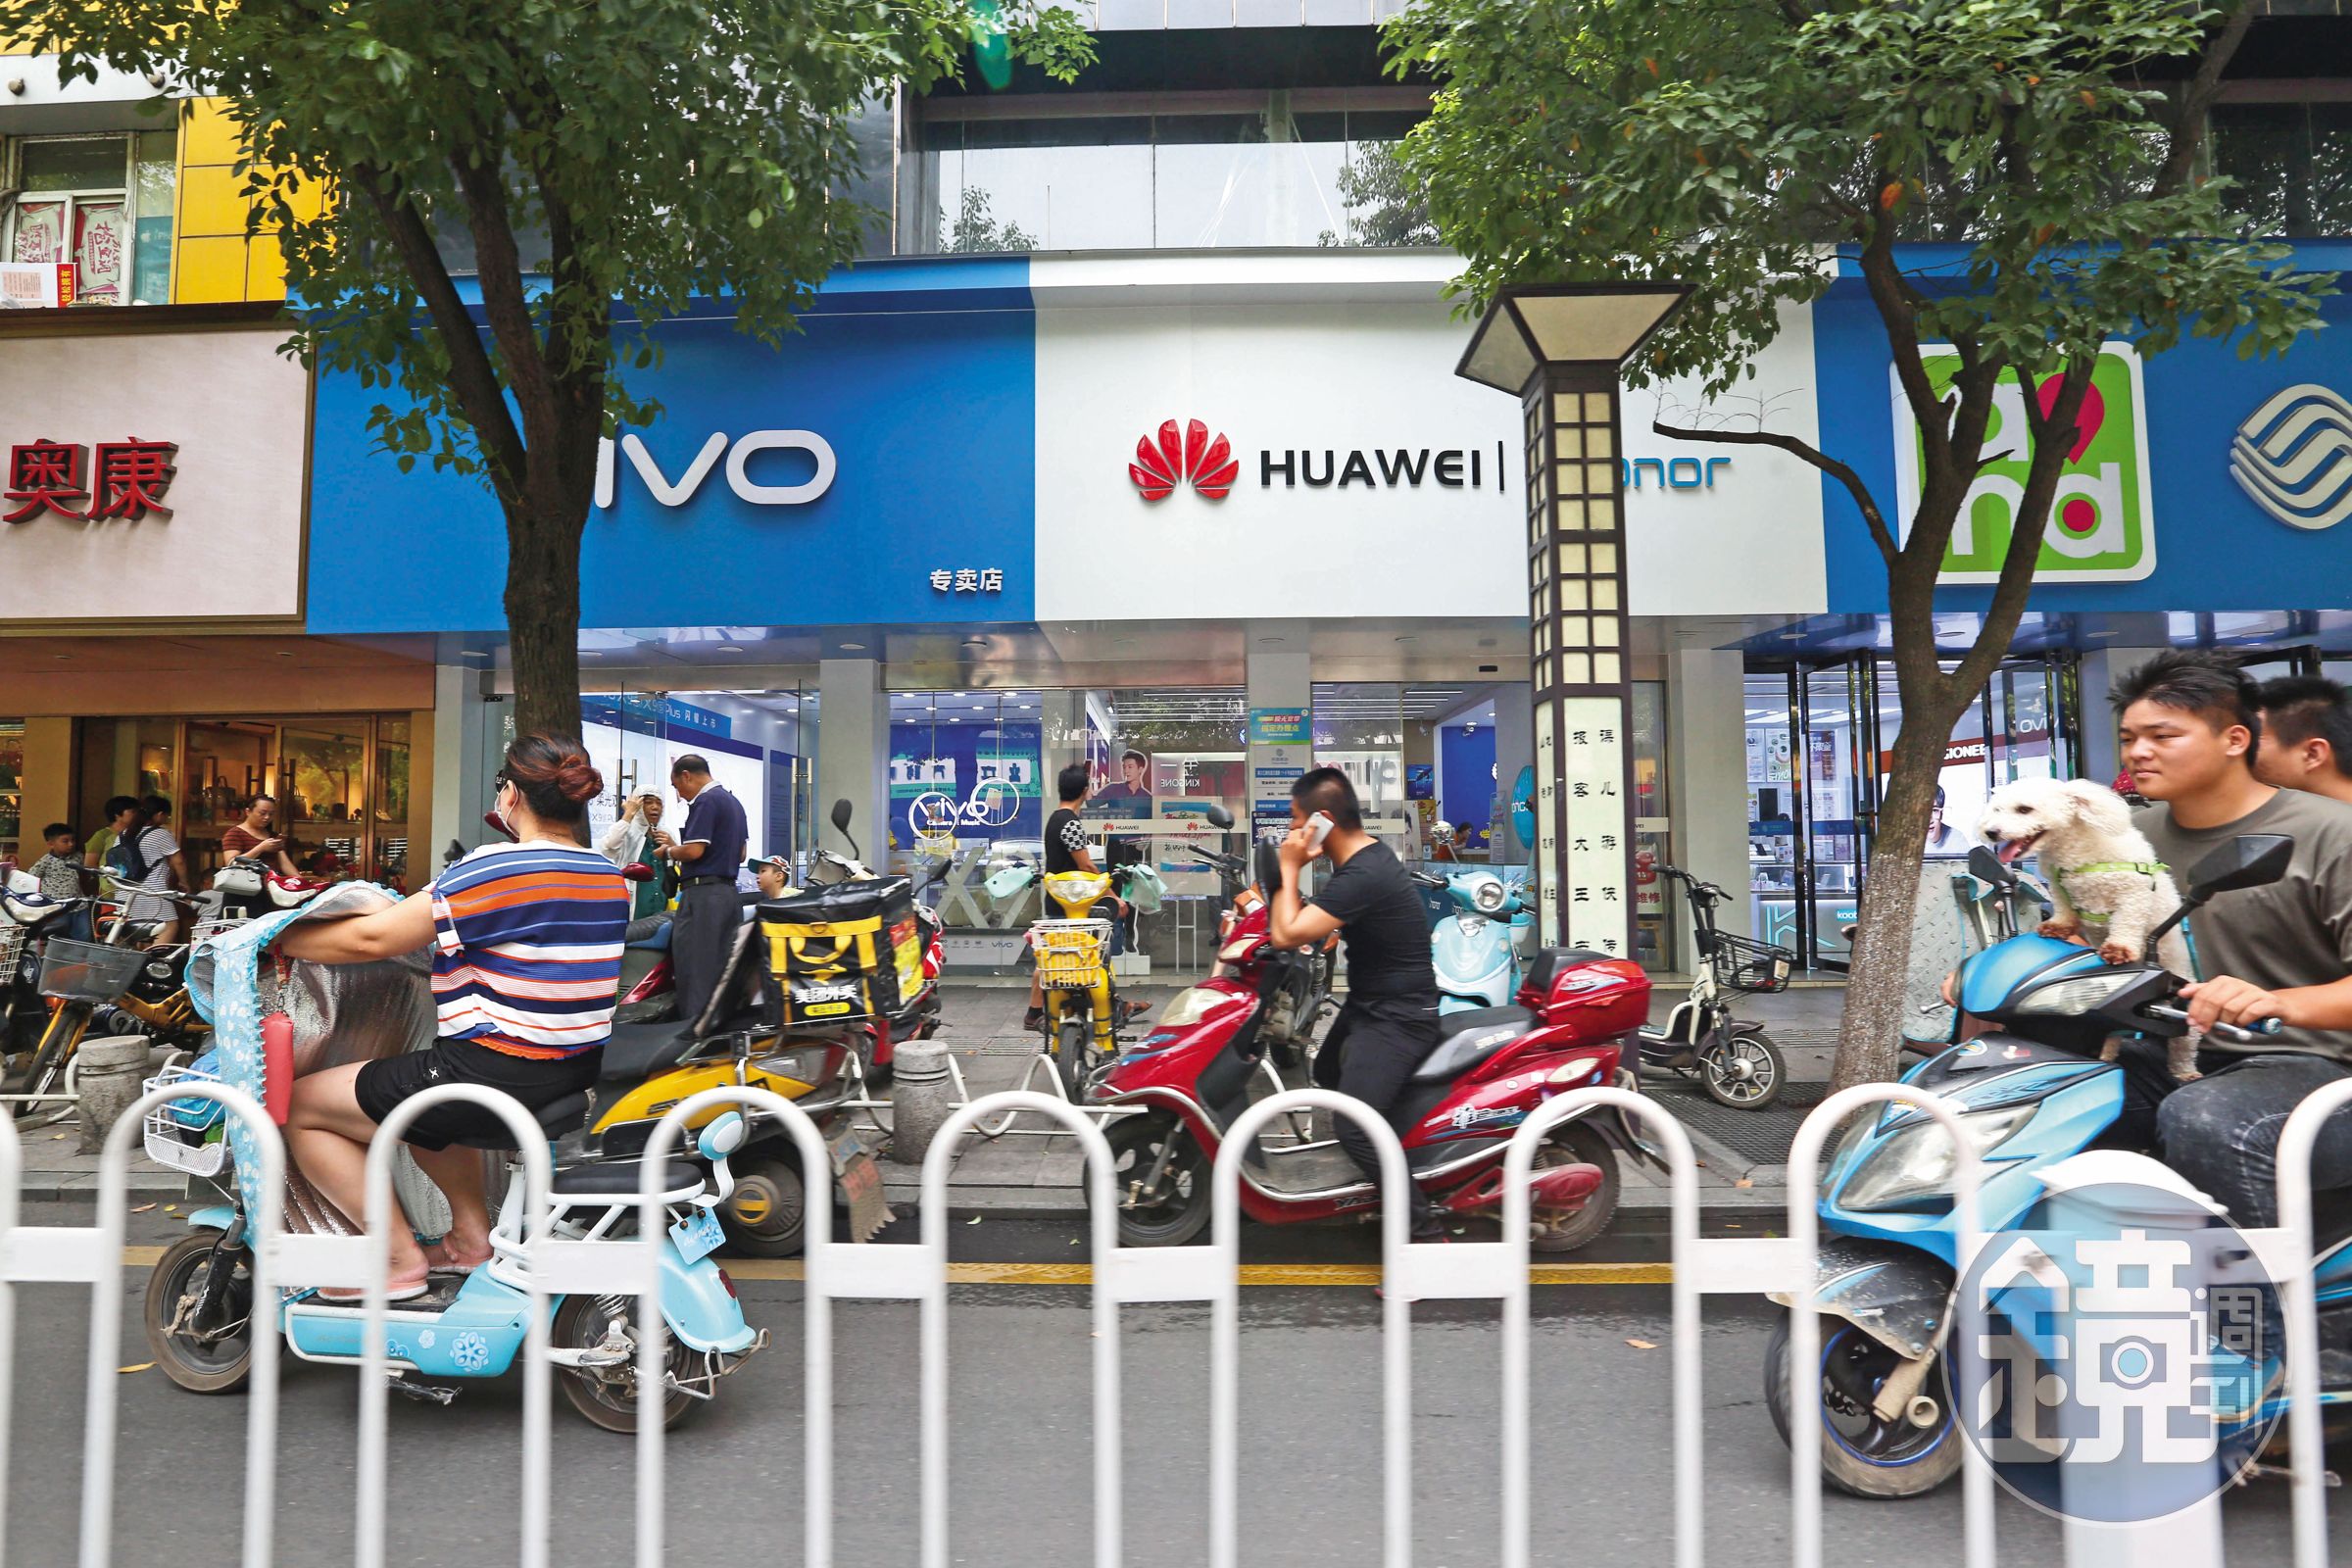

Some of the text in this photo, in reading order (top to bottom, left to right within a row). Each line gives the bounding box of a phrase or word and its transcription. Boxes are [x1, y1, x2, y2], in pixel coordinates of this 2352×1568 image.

[3, 436, 179, 524] 奥康
[594, 412, 837, 509] ivo
[1260, 448, 1733, 489] HUAWEI nor
[929, 567, 1004, 592] 专卖店
